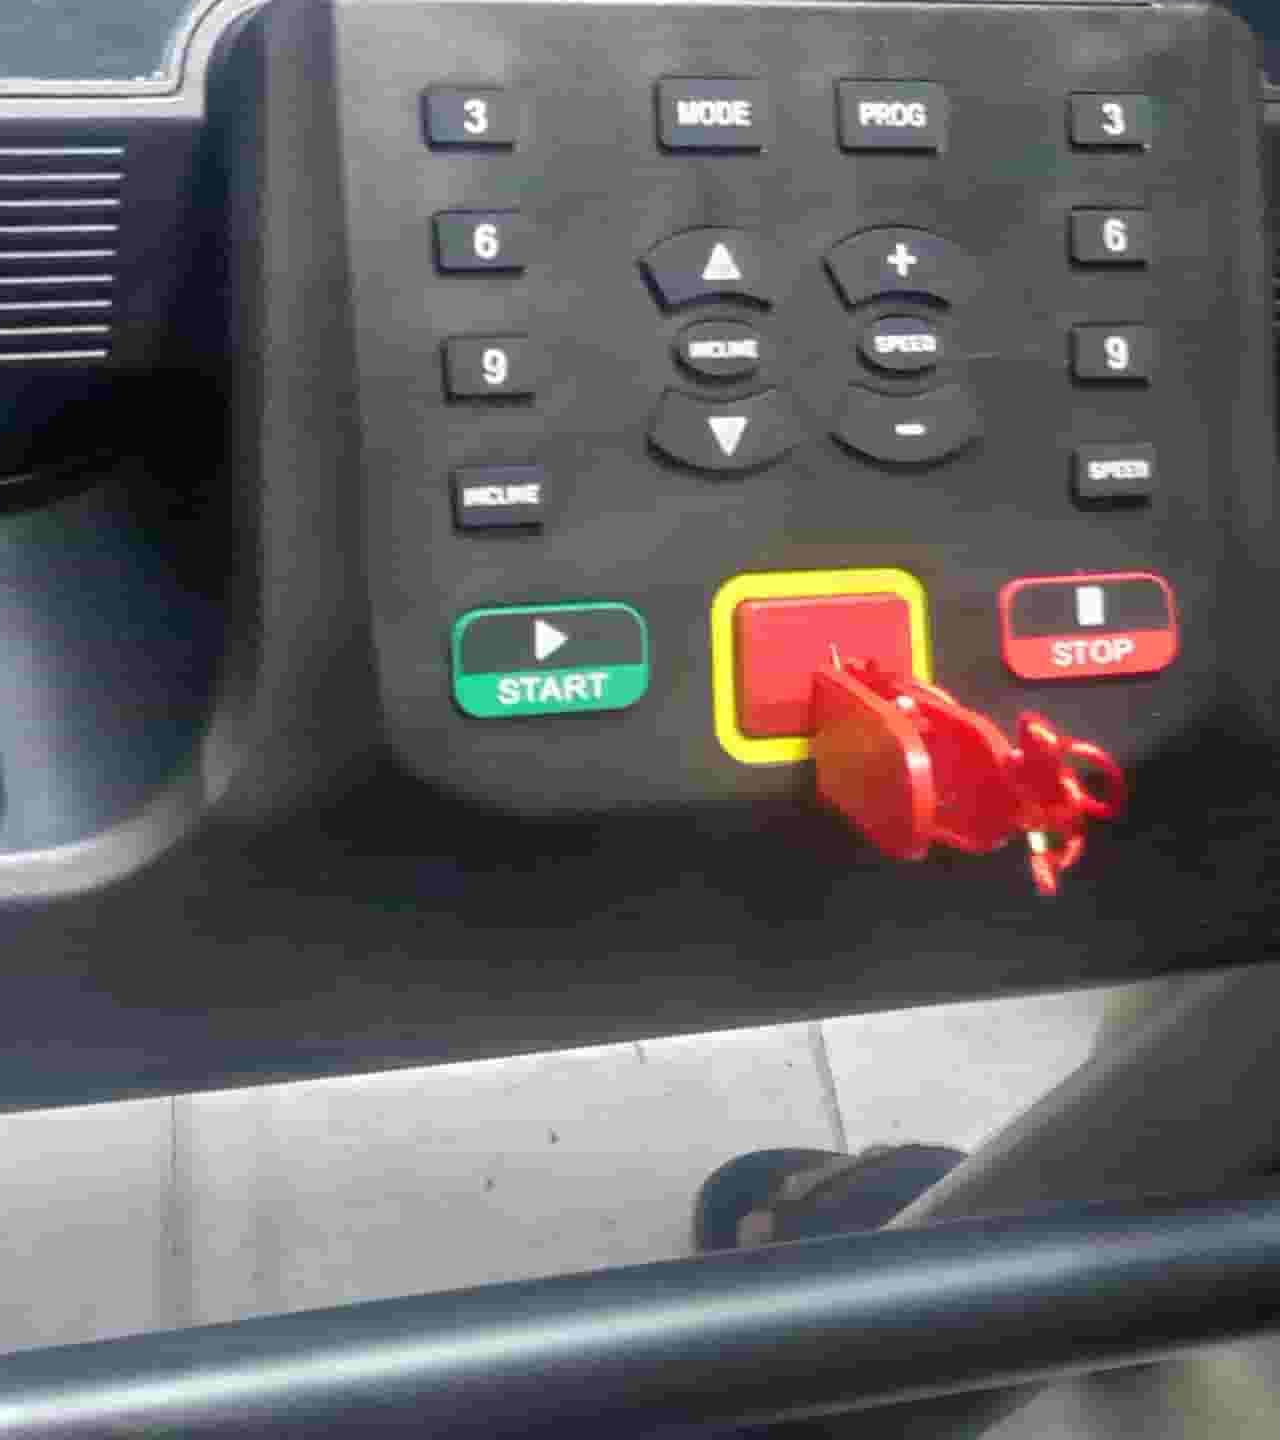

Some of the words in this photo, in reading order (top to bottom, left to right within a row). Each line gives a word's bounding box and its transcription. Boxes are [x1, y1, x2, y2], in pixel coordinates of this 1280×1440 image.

[463, 98, 489, 134] 3
[676, 99, 754, 127] MODE
[858, 100, 927, 128] PROG
[1101, 101, 1126, 135] 3
[472, 223, 499, 260] 6
[1102, 217, 1127, 253] 6
[873, 334, 937, 353] SPEED
[1103, 335, 1130, 371] 9
[481, 347, 509, 385] 9
[1051, 638, 1134, 667] STOP
[496, 672, 608, 706] START
